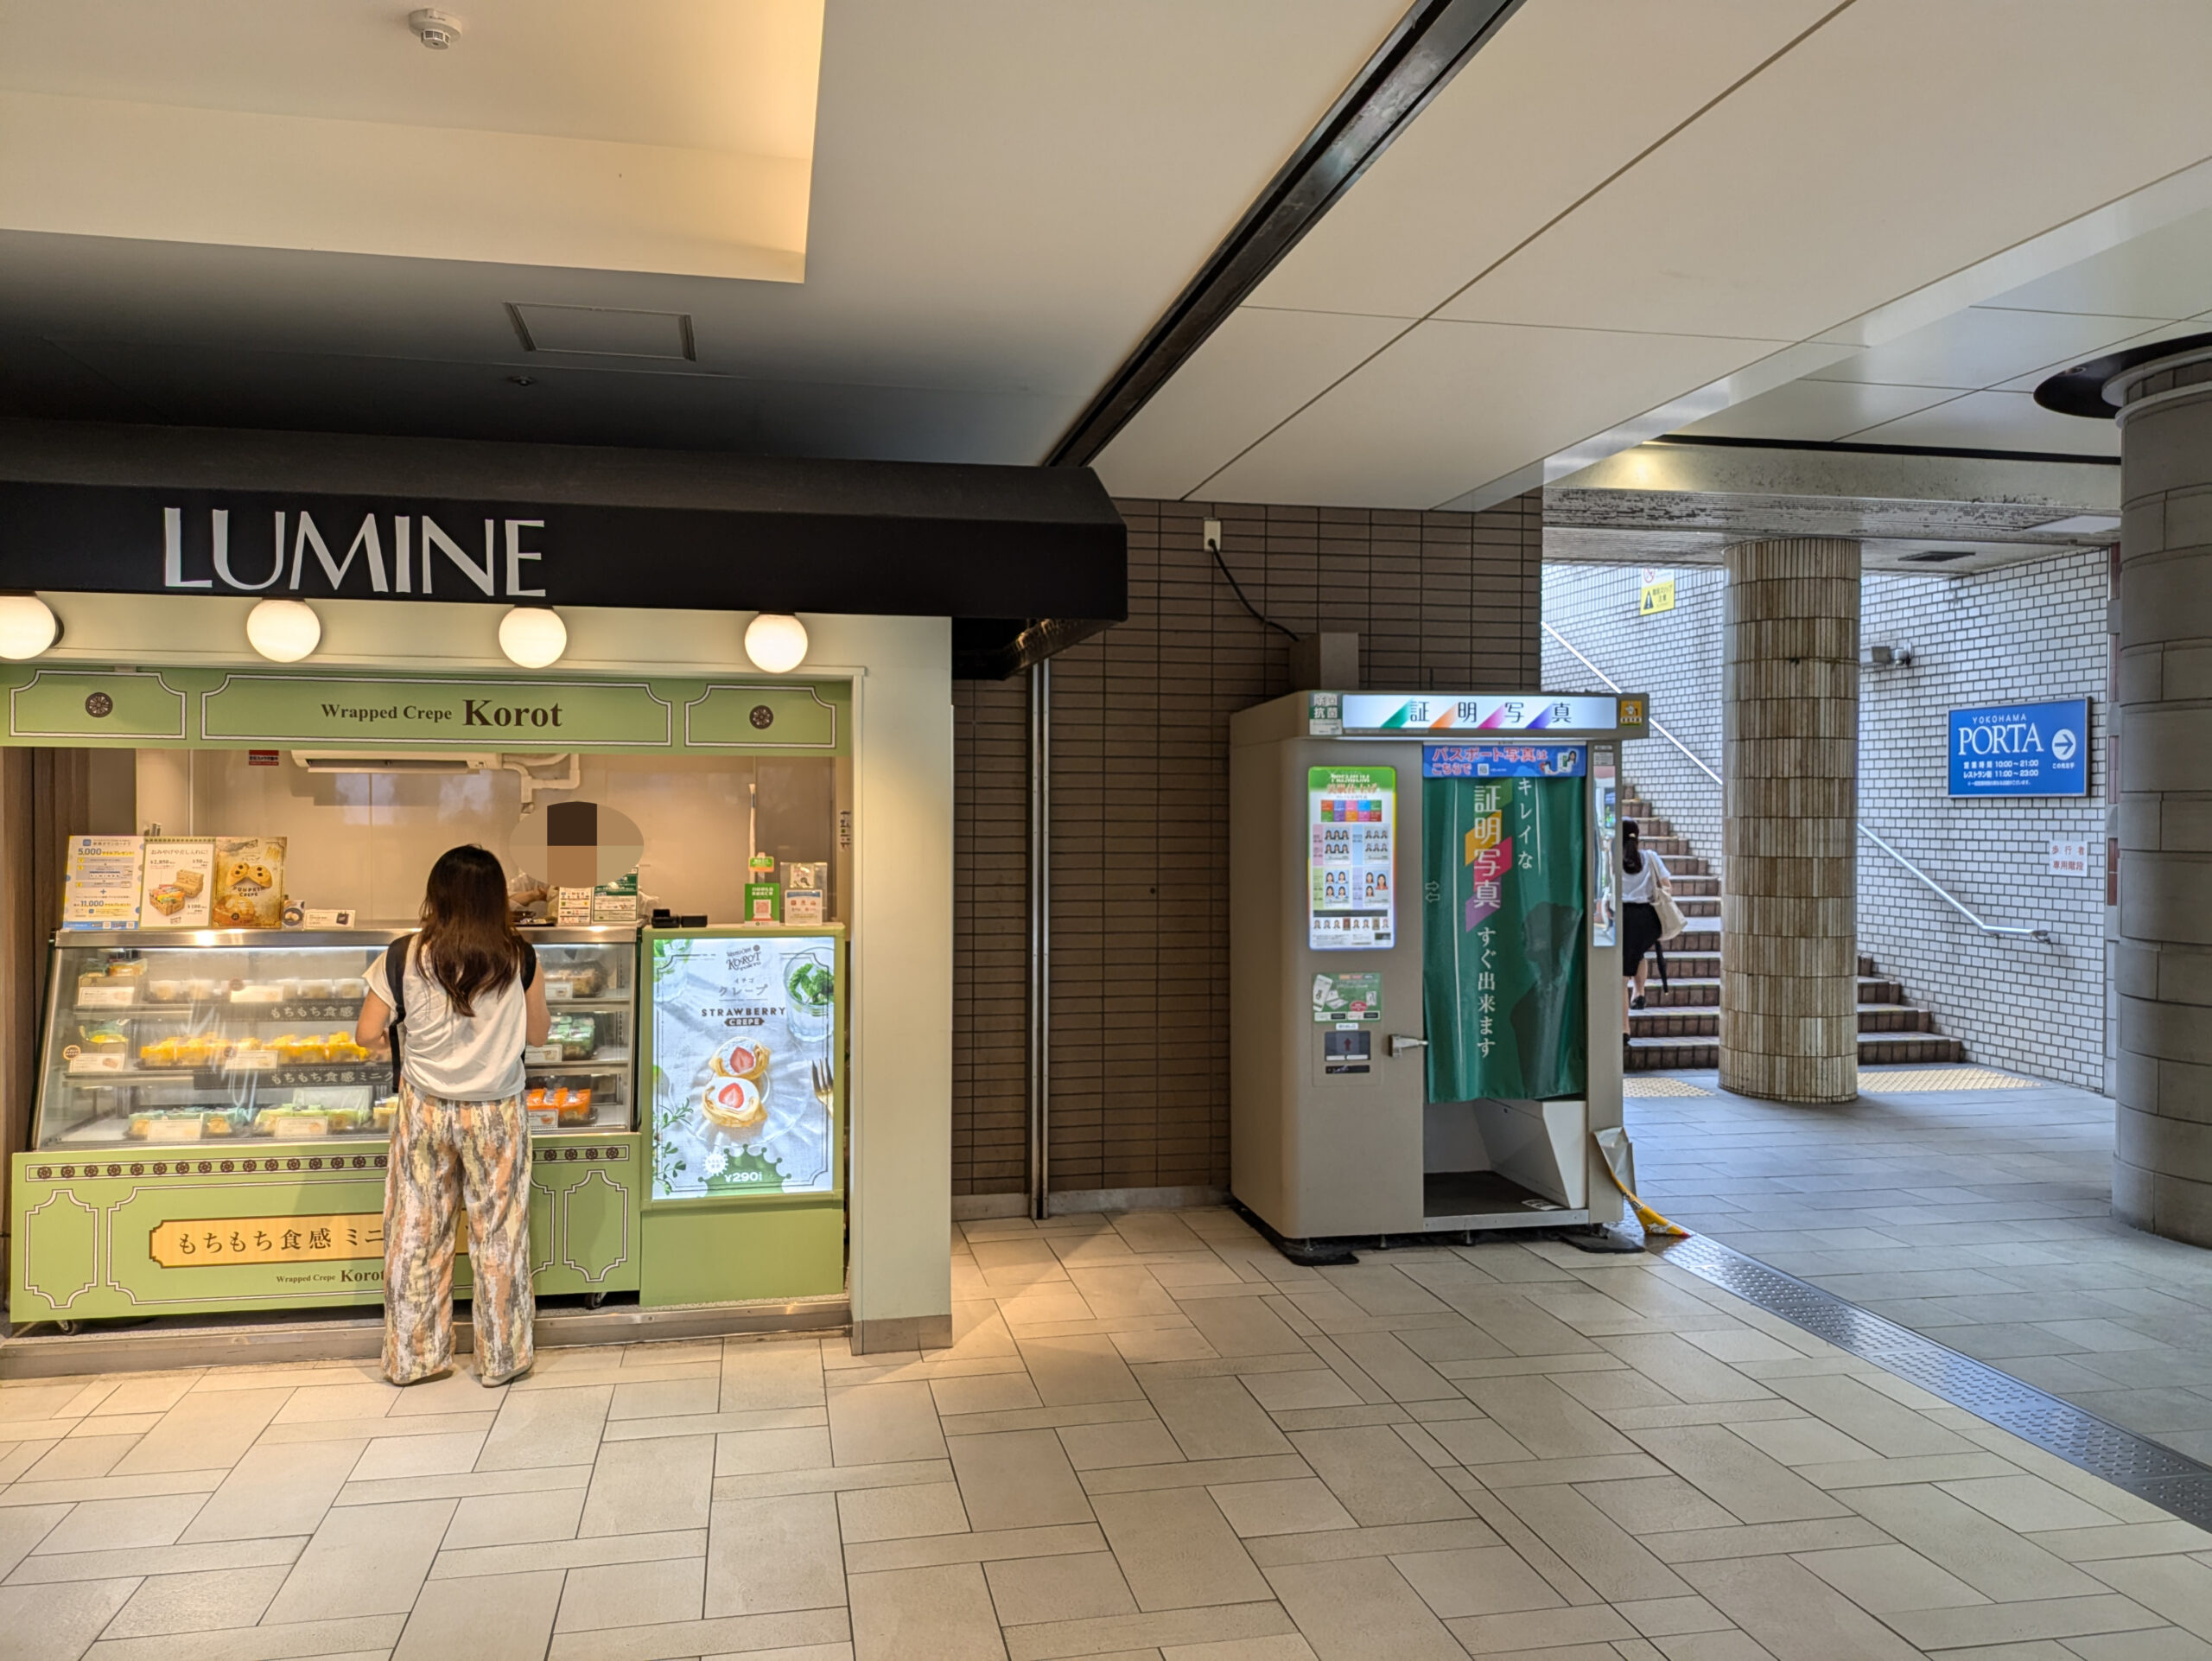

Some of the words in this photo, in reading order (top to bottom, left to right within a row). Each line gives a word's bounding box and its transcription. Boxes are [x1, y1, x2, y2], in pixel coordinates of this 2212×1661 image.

[164, 507, 546, 597] LUMINE
[321, 703, 398, 722] Wrapped
[403, 705, 453, 722] Crepe
[462, 699, 563, 728] Korot
[1314, 707, 1338, 719] 抗菌
[1410, 700, 1572, 723] 証明写真
[1972, 713, 2027, 724] YOKOHAMA
[1958, 722, 2044, 755] PORTA
[1433, 747, 1548, 762] パスポート写真は
[1431, 762, 1472, 775] こちらで
[1963, 760, 1993, 770] 営業時間
[1331, 773, 1370, 783] PREMIUM
[1963, 770, 1993, 779] レストラン街
[1517, 777, 1534, 869] キレイな
[1473, 785, 1502, 908] 証明写真
[2051, 845, 2085, 856] 歩行者
[2052, 860, 2084, 871] 専用階段
[726, 951, 761, 971] KOROT
[719, 983, 768, 996] クレープ
[1477, 926, 1497, 1057] すぐ出来ます
[270, 1006, 354, 1018] もちもち食感
[702, 1007, 785, 1017] STRAWBERRY
[271, 1071, 355, 1085] もちもち食感
[179, 1227, 332, 1255] もちもち食感
[346, 1227, 385, 1246] ミニ
[276, 1275, 311, 1284] Wrapped
[313, 1273, 336, 1282] Crepe
[340, 1268, 385, 1283] Korot
